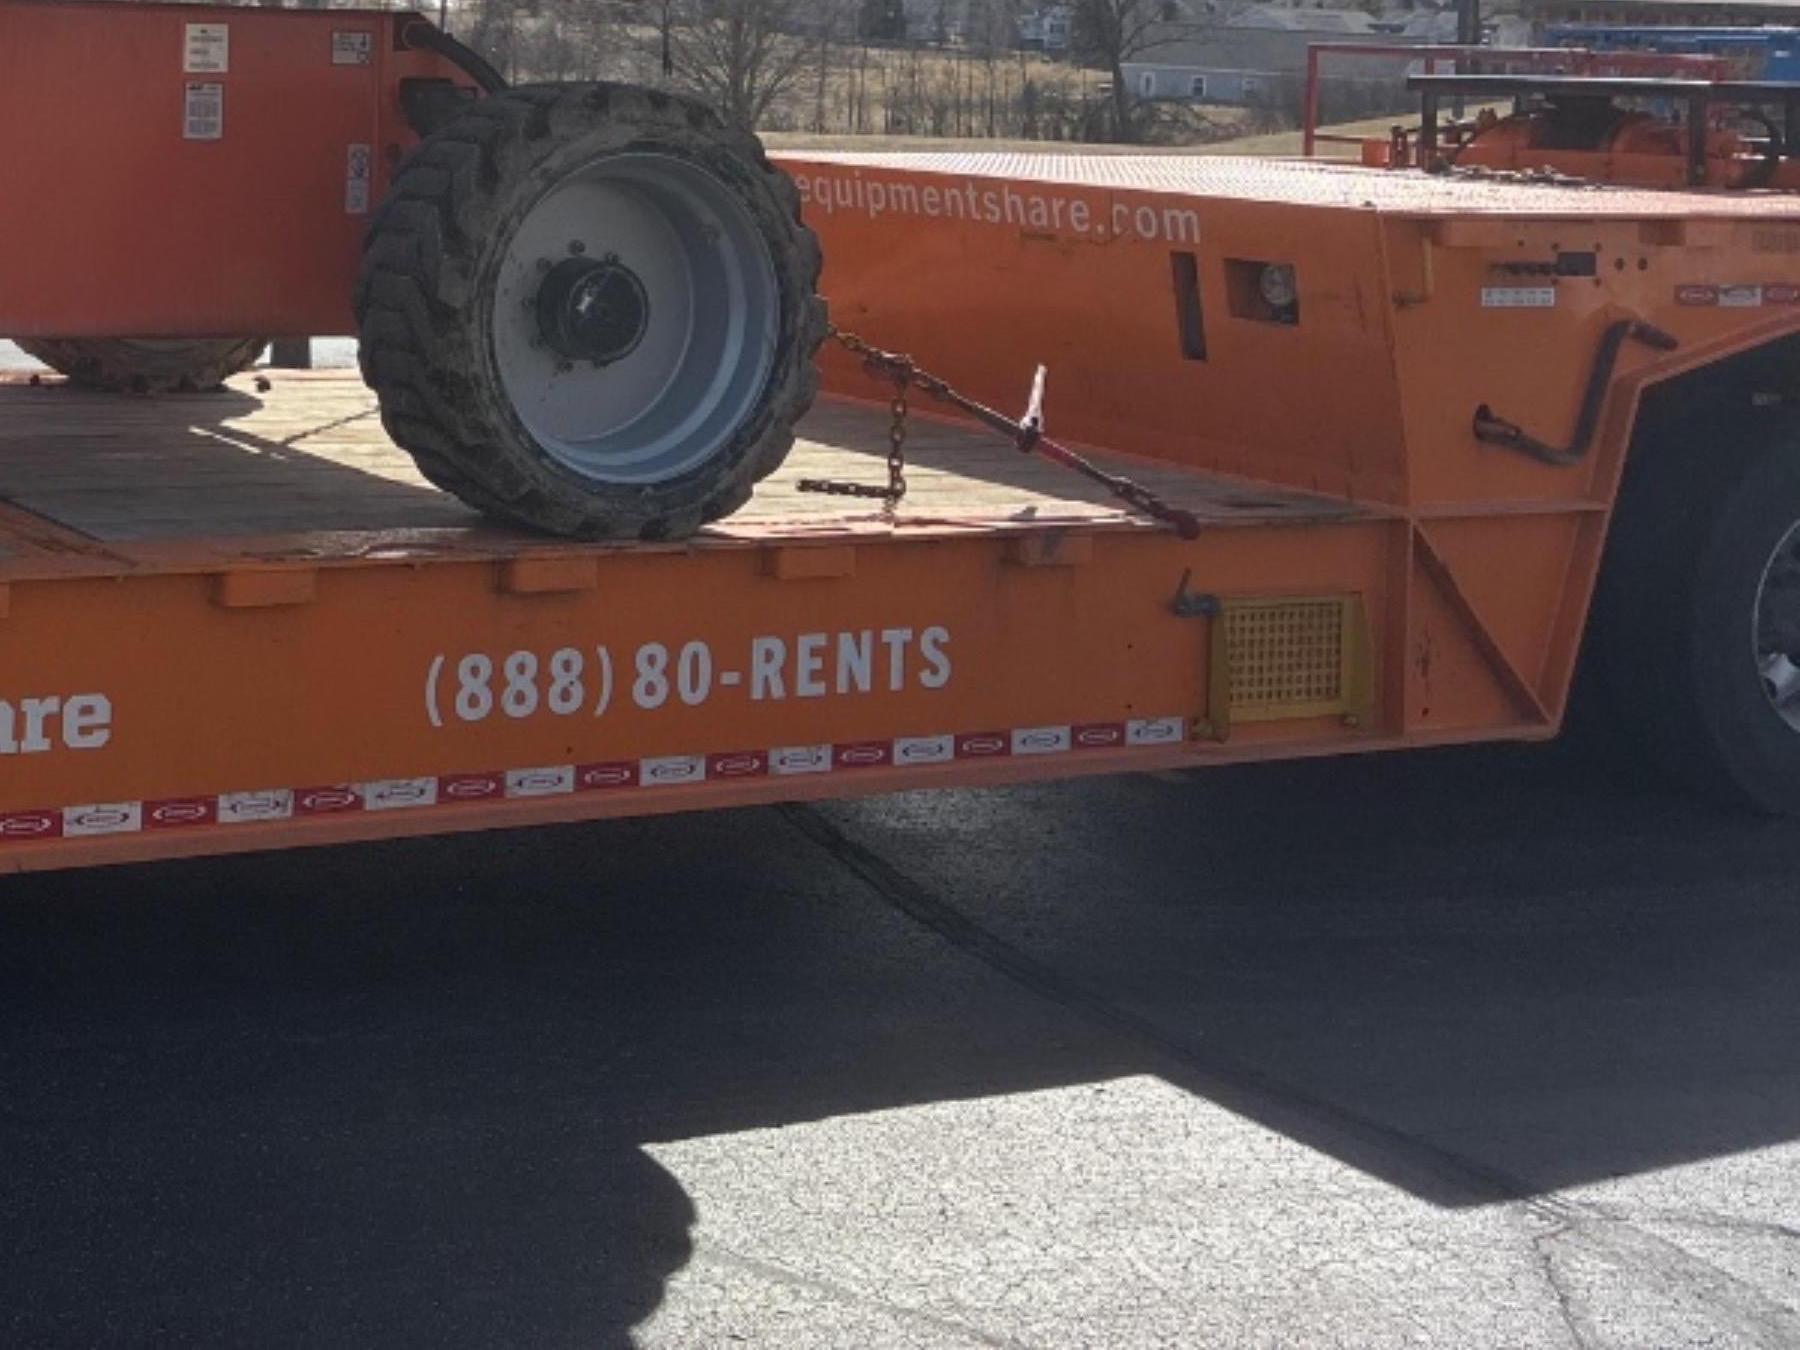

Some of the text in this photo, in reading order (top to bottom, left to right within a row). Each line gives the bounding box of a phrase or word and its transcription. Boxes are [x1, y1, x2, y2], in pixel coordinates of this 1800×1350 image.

[799, 171, 1200, 244] equipmentshare.com
[425, 625, 952, 727] (888) 80-RENTS
